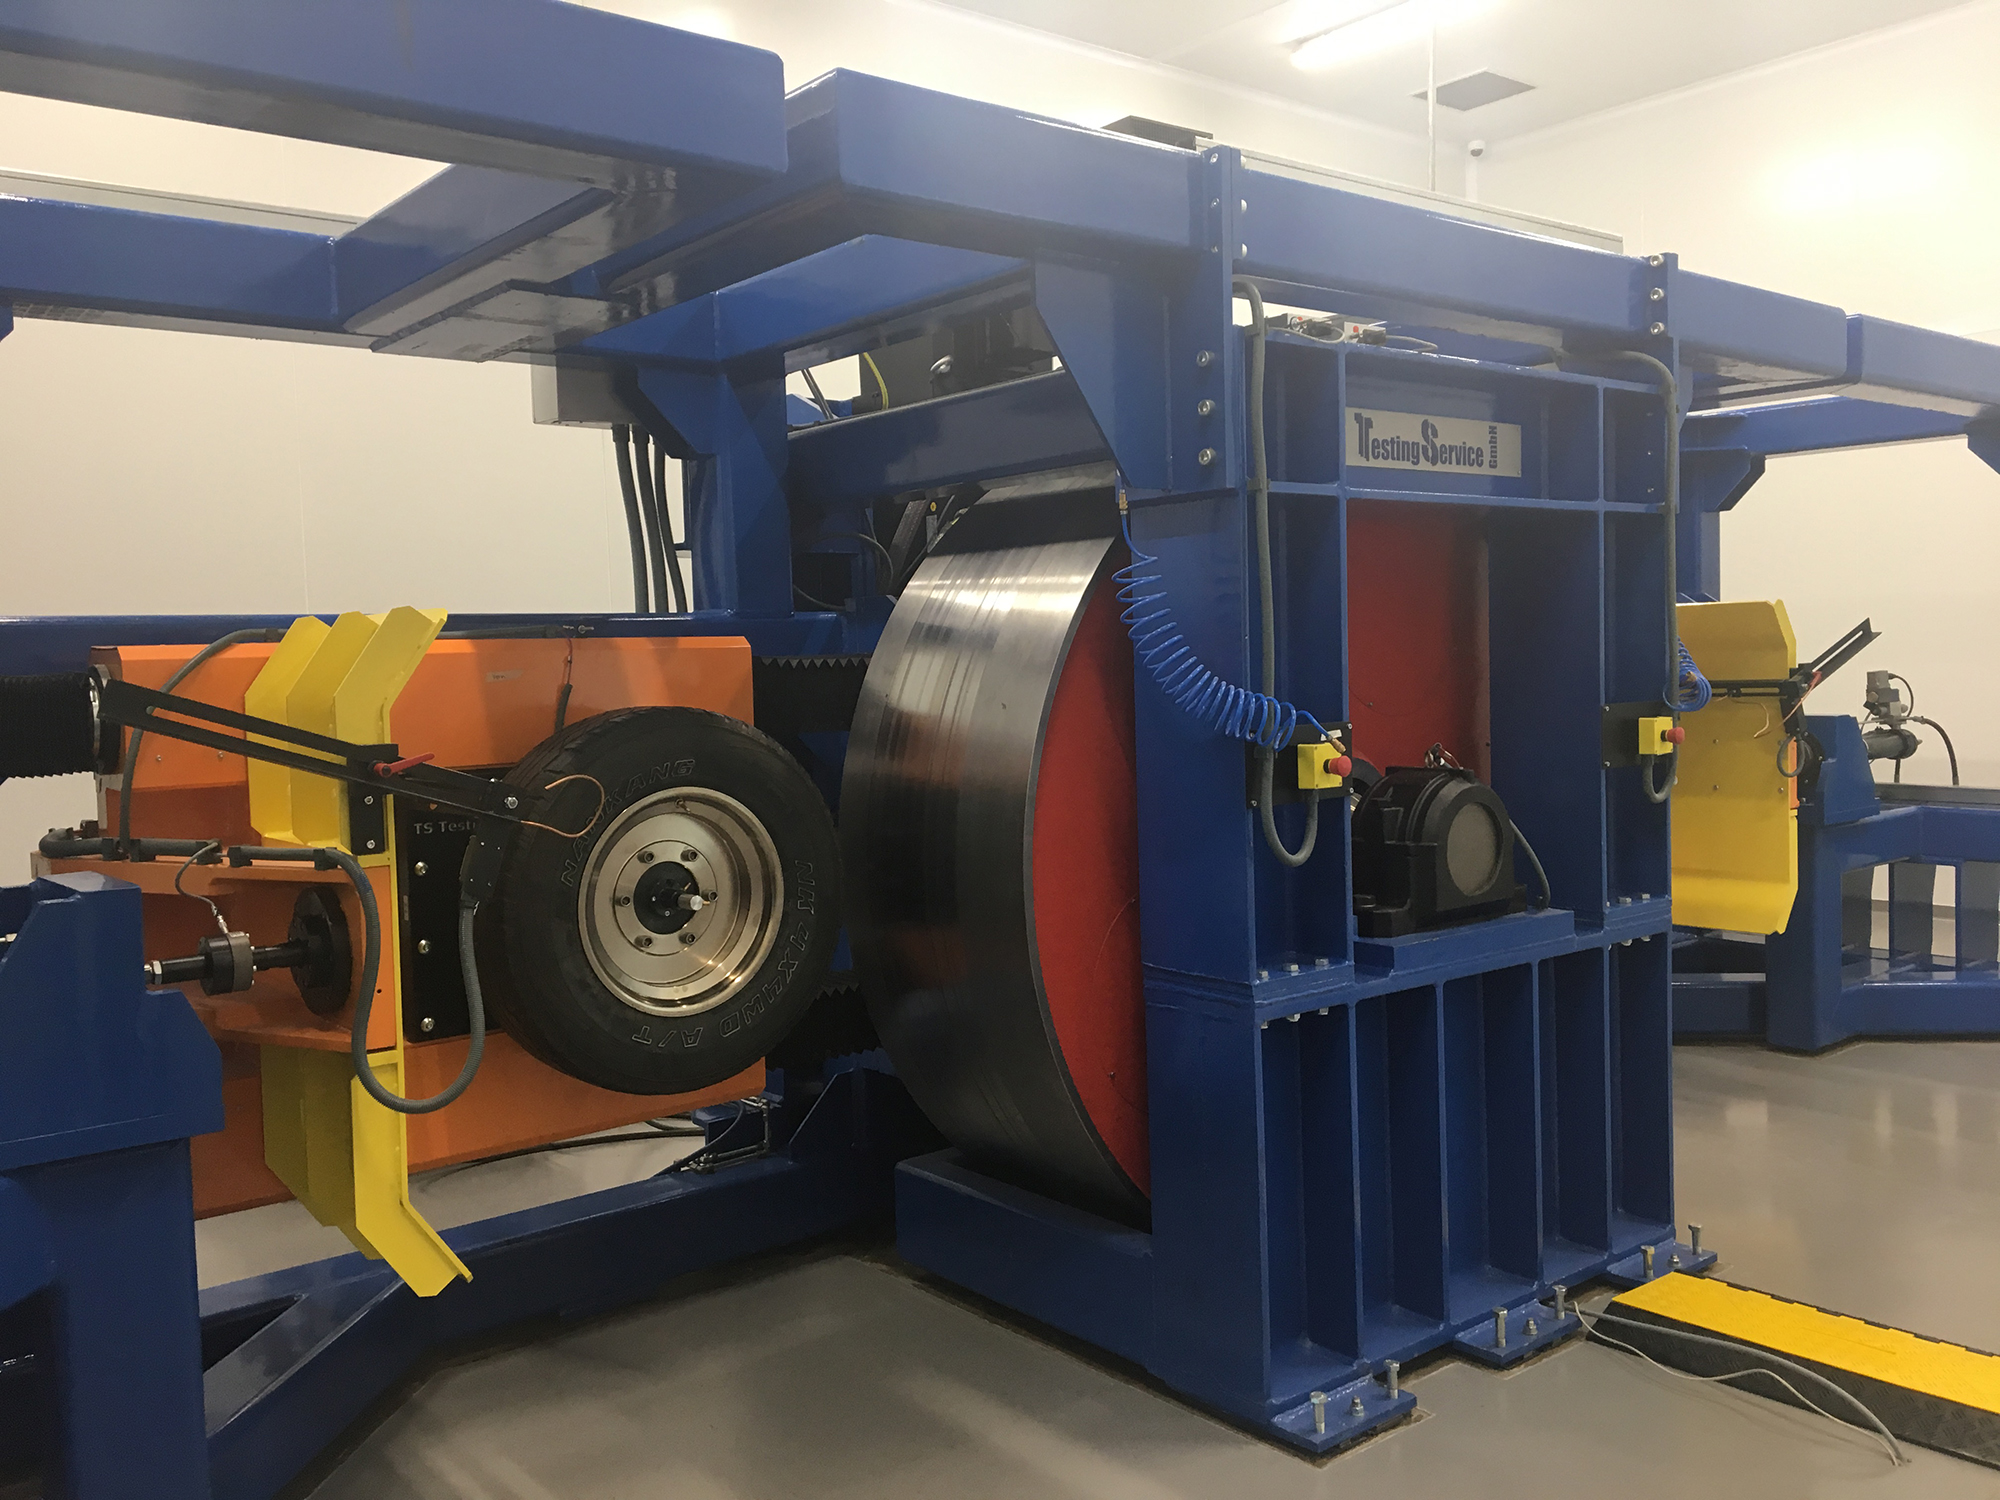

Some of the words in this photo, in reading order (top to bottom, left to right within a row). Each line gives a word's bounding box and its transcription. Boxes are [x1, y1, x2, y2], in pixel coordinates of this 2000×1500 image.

[413, 821, 433, 835] TS
[438, 820, 477, 833] Testi
[560, 758, 696, 887] NANKANG
[794, 859, 816, 915] NK
[631, 1025, 704, 1048] A/T
